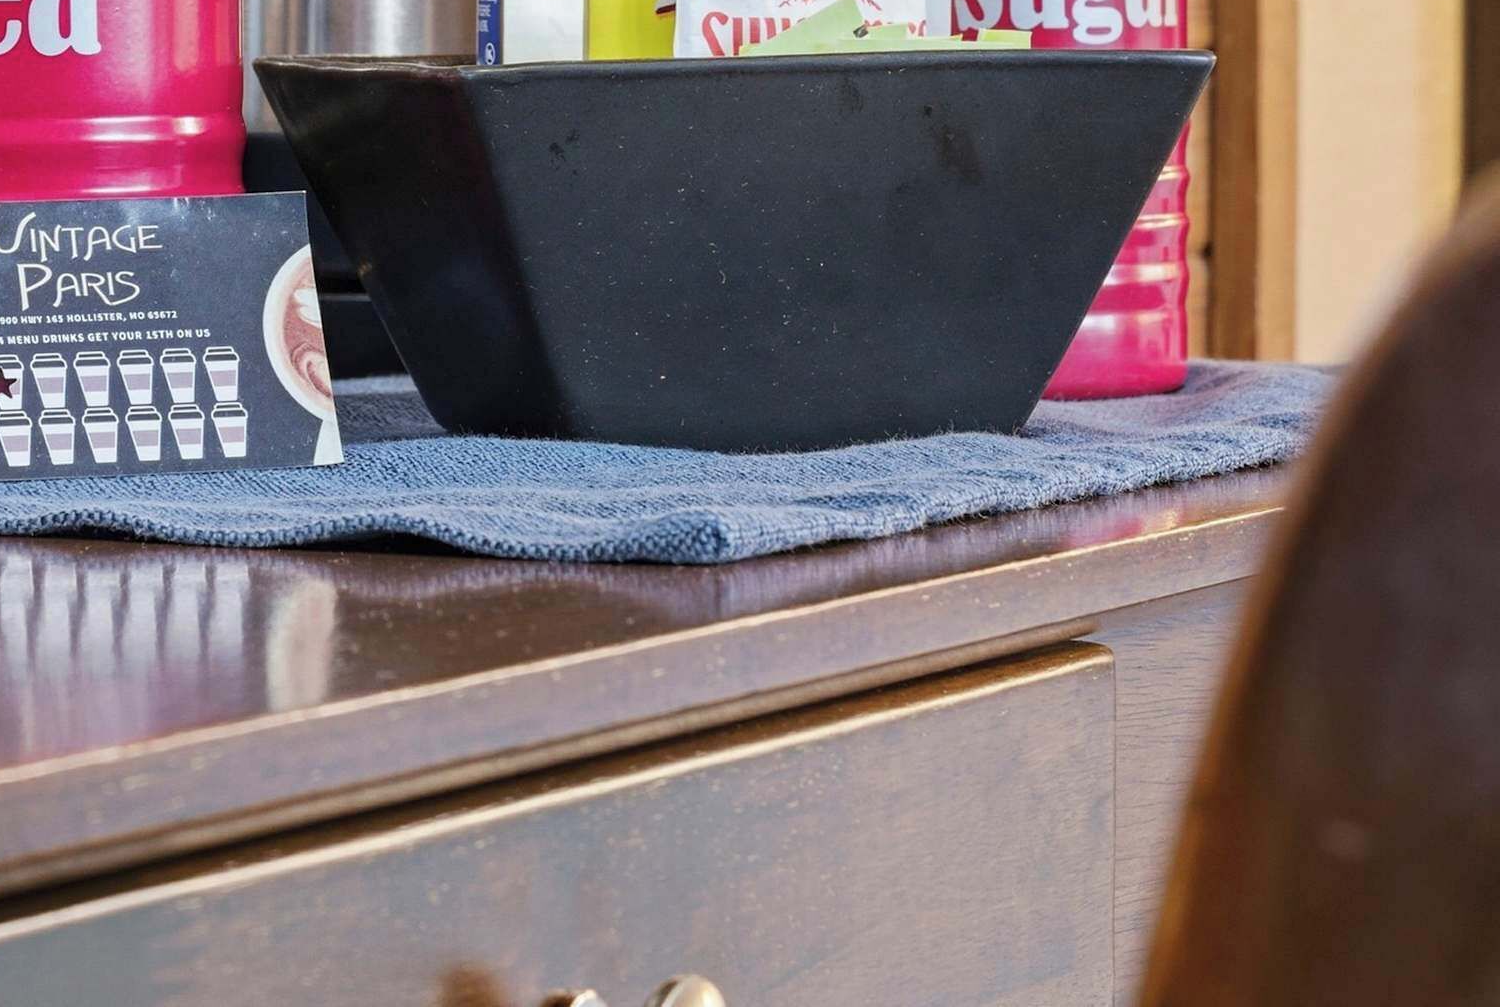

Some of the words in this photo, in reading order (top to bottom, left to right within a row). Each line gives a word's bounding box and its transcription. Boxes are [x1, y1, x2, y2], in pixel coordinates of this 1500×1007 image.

[17, 263, 140, 311] PARIS
[20, 315, 43, 325] HWY
[7, 334, 39, 345] MENU
[42, 332, 84, 344] DRINKS
[87, 332, 109, 342] GET
[111, 331, 142, 341] YOUR
[146, 330, 173, 340] 15TH
[177, 329, 193, 339] ON
[195, 328, 211, 338] US
